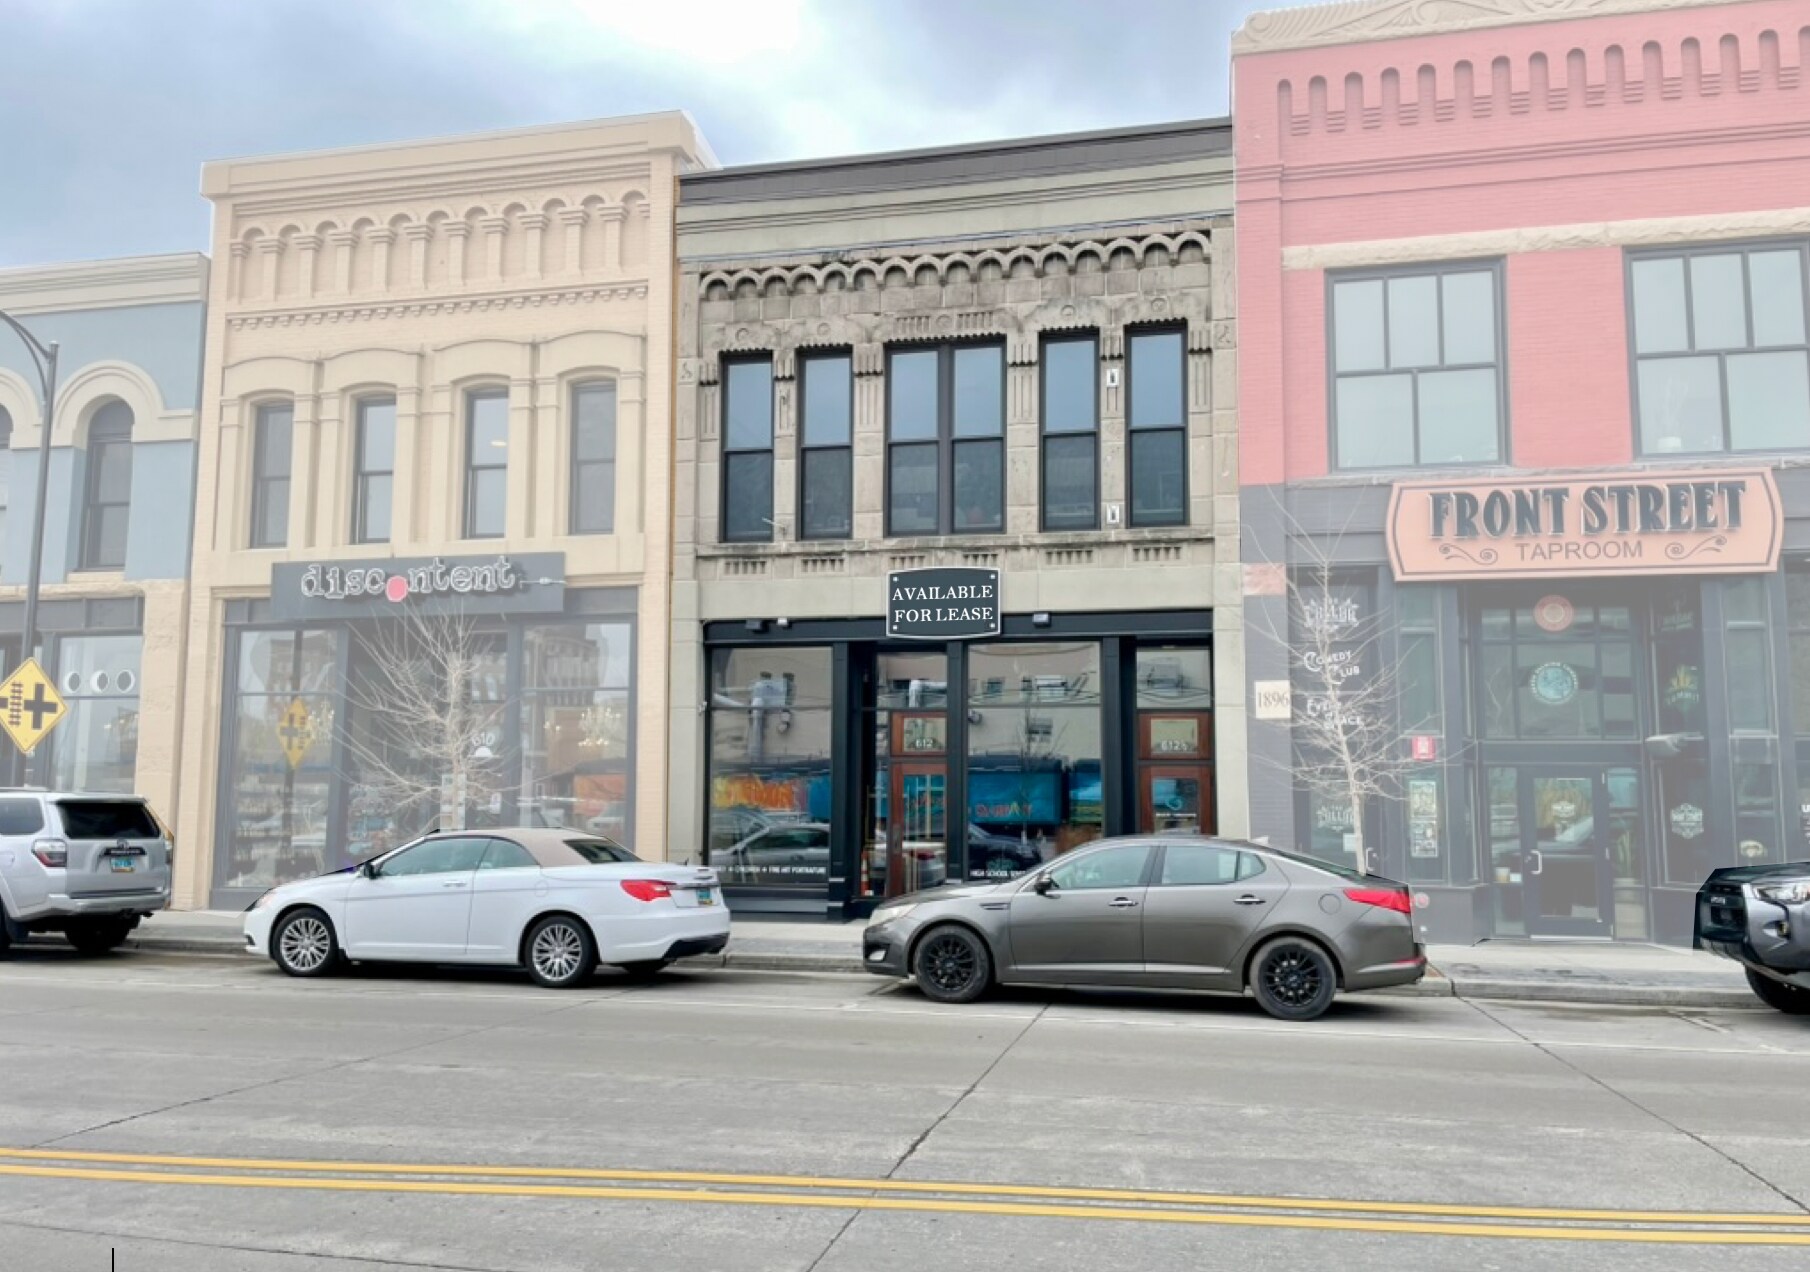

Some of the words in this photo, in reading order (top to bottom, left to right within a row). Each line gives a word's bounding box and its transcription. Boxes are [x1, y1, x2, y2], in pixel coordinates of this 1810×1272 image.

[1428, 487, 1570, 539] FRONT
[1580, 480, 1746, 536] STREET
[1515, 541, 1643, 562] TAPROOM
[301, 556, 515, 602] discontent
[892, 585, 993, 601] AVAILABLE
[894, 609, 932, 623] FOR
[935, 607, 994, 622] LEASE
[1257, 692, 1289, 708] 1896
